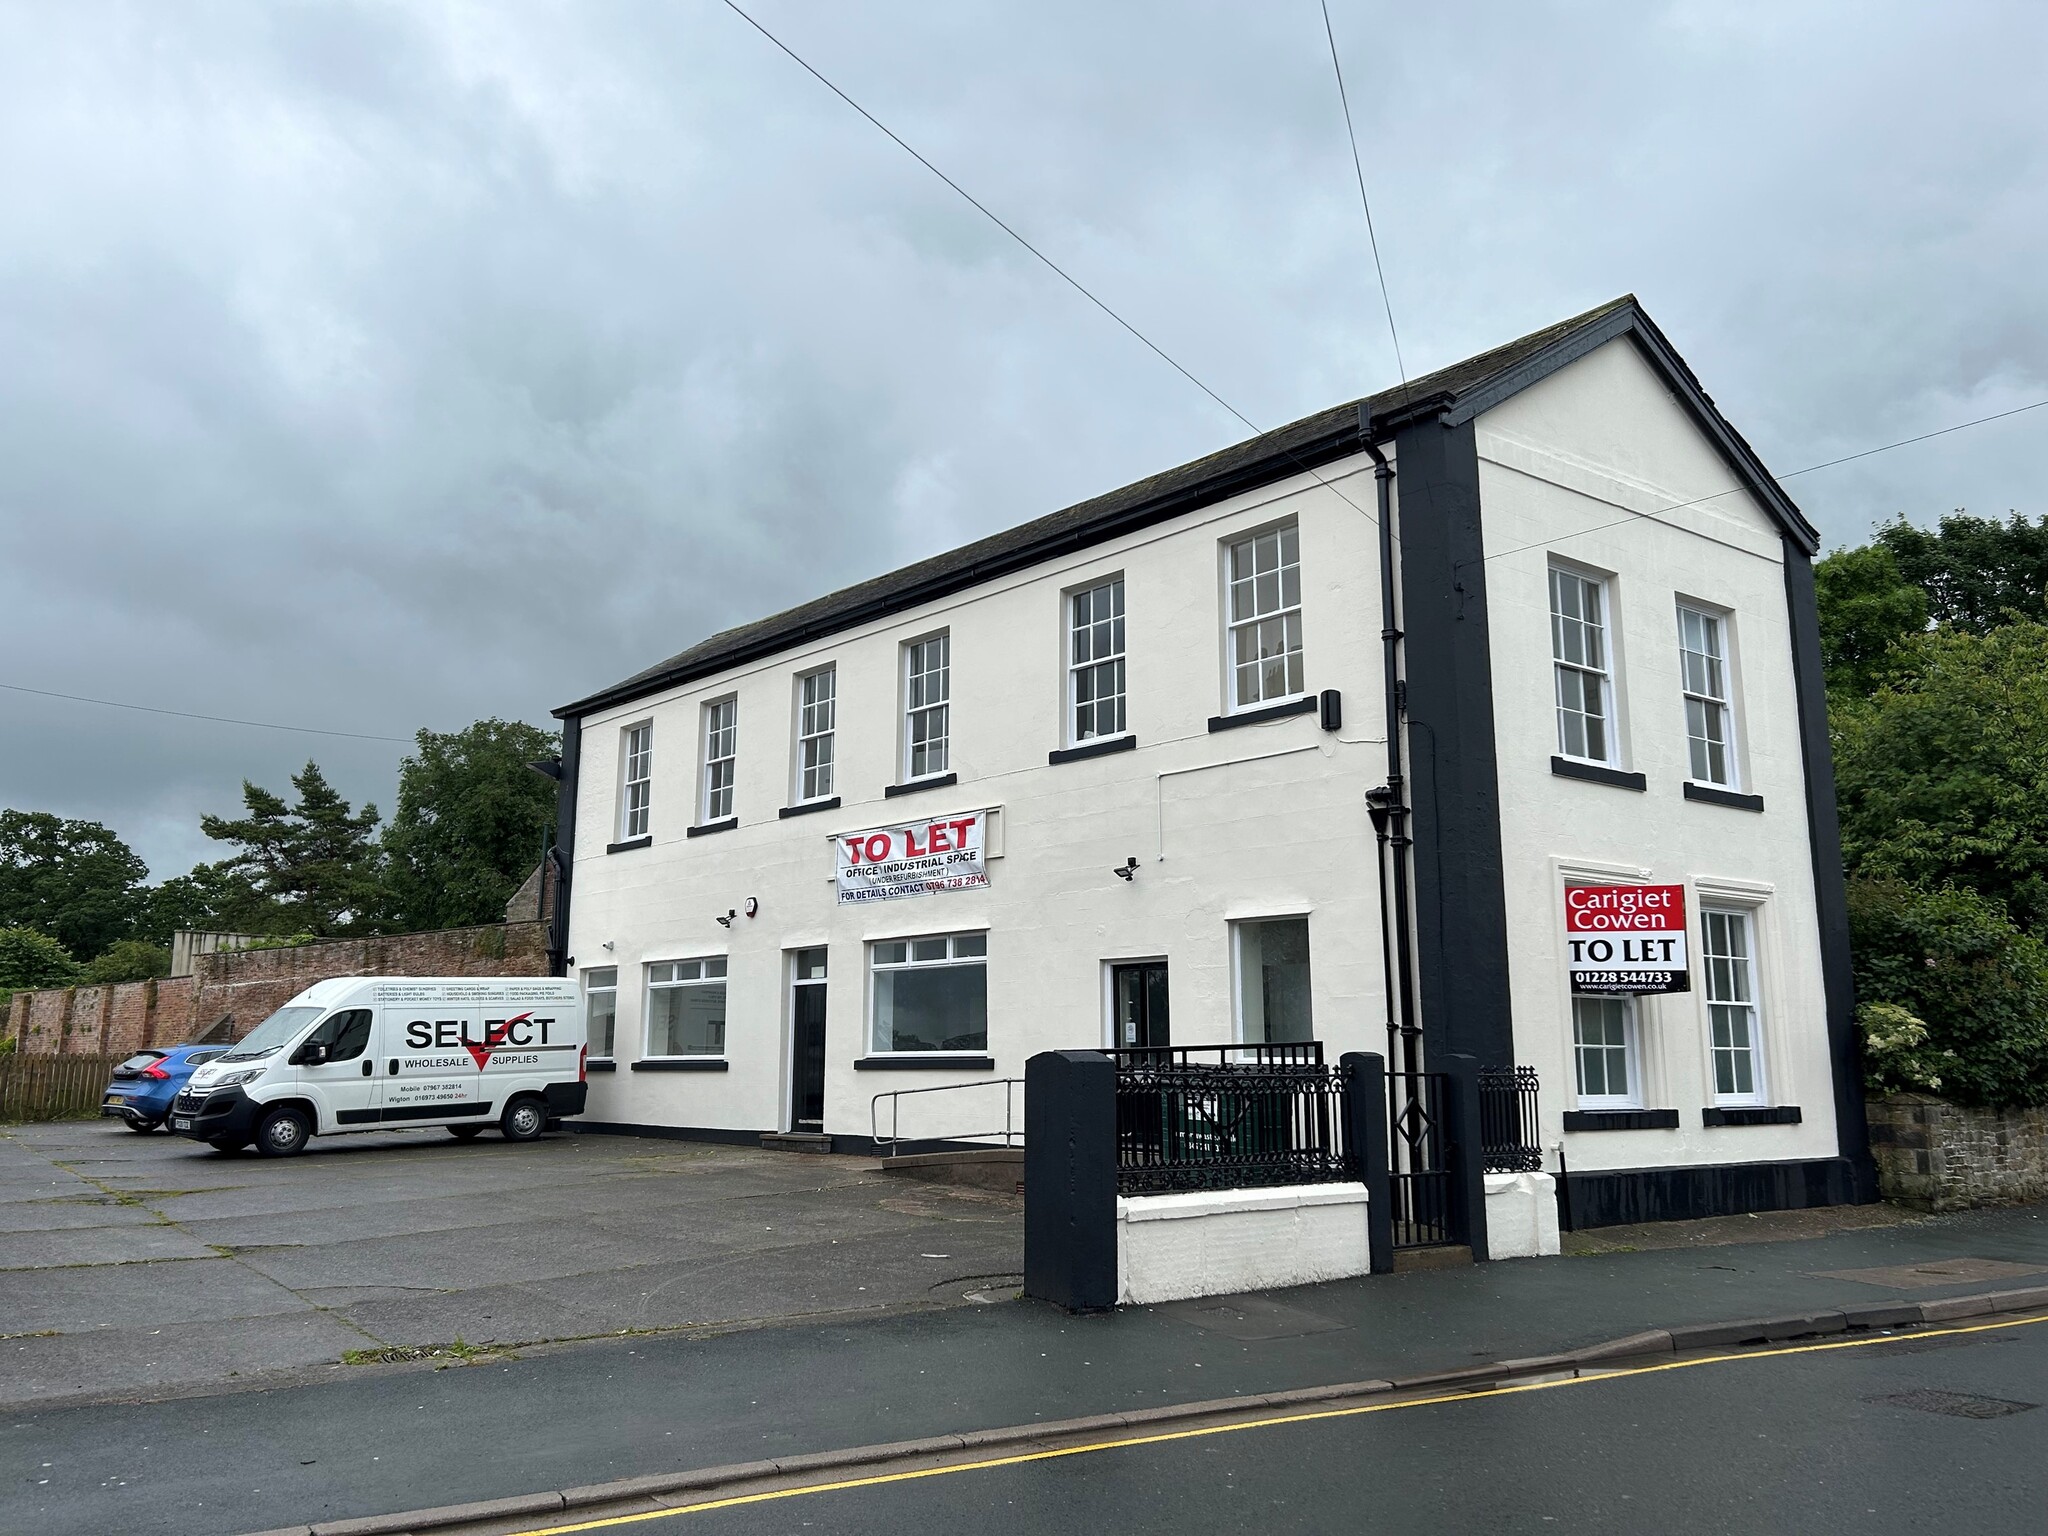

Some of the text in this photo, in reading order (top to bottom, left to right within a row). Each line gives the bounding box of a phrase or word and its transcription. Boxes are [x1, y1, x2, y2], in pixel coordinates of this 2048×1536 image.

[846, 818, 976, 864] TO LET
[846, 866, 879, 878] OFFICE
[883, 857, 944, 873] INDUSTRIAL
[946, 851, 977, 865] SPACE
[841, 891, 856, 901] FOR
[856, 888, 887, 899] DETAILS
[888, 883, 924, 896] CONTACT
[925, 880, 945, 891] 0796
[1568, 889, 1671, 914] Carigiet
[1574, 910, 1666, 929] Cowen
[1568, 939, 1676, 962] TO LET
[1576, 971, 1672, 983] 01228 544733
[1580, 983, 1667, 991] www.carigietcowen.co.uk
[405, 1018, 555, 1049] SELECT
[405, 1055, 538, 1068] WHOLESALE SUPPLIES
